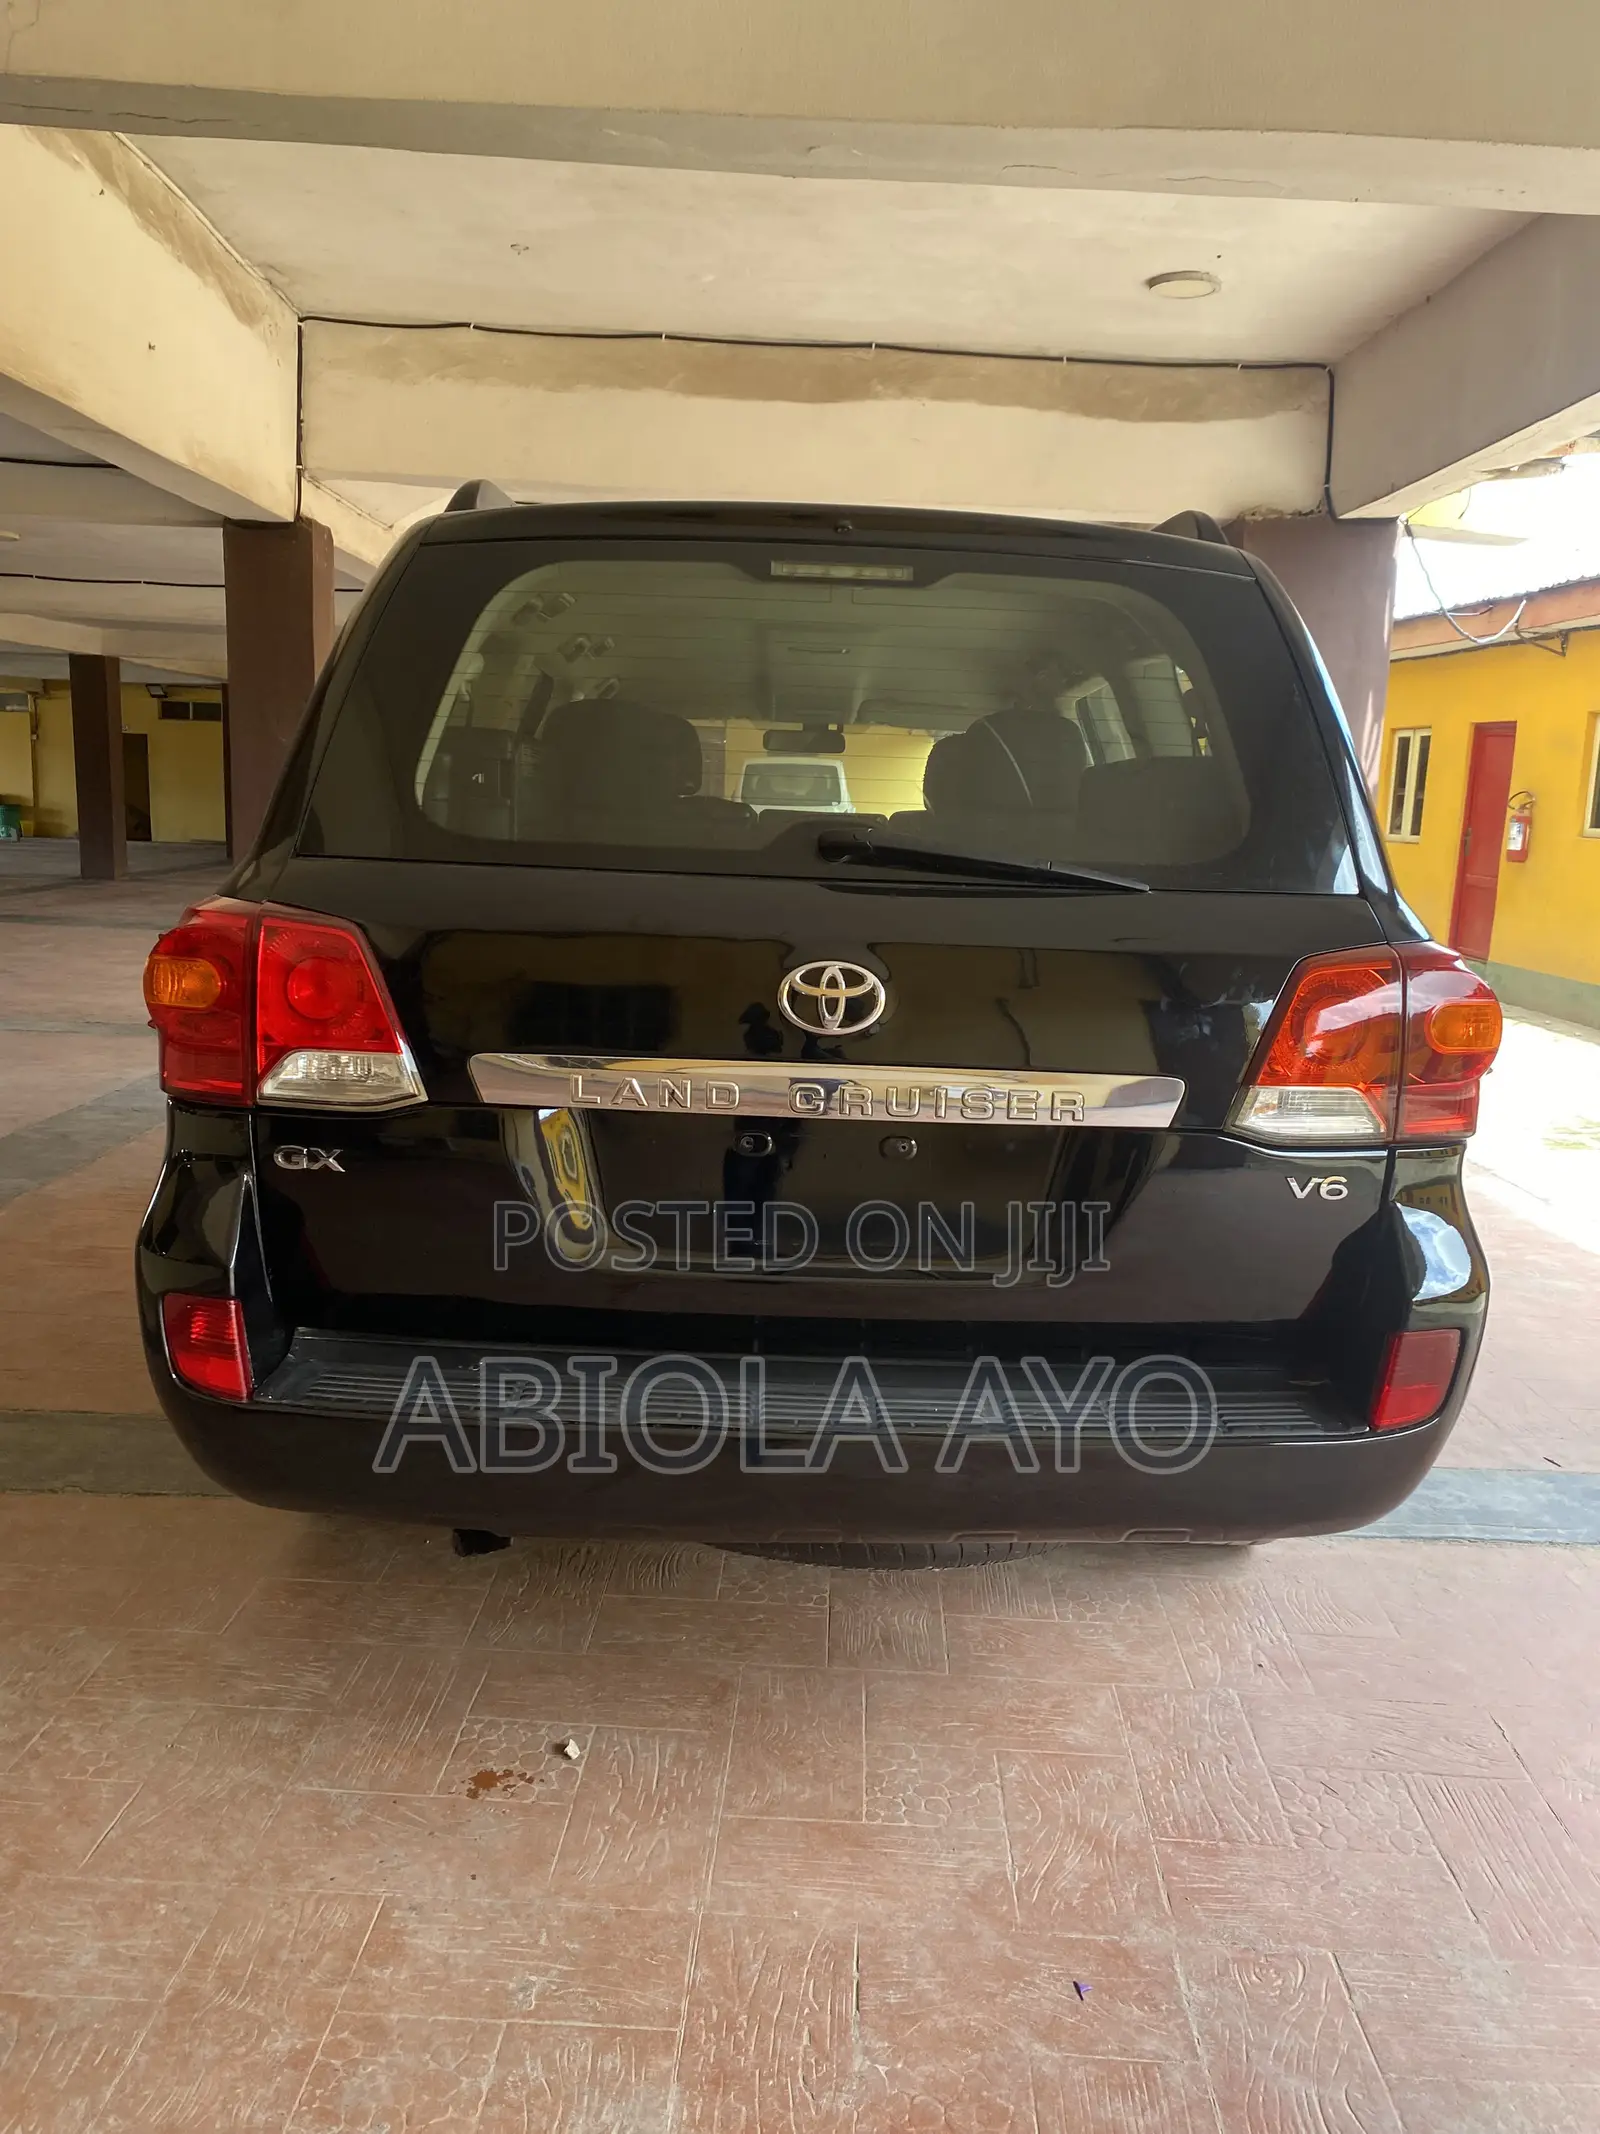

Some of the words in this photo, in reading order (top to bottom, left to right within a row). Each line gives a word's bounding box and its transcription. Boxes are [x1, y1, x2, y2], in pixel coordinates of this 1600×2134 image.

[569, 1074, 741, 1111] LAND
[789, 1082, 1086, 1122] CRUISER
[274, 1145, 346, 1172] GX
[1286, 1176, 1349, 1200] V6
